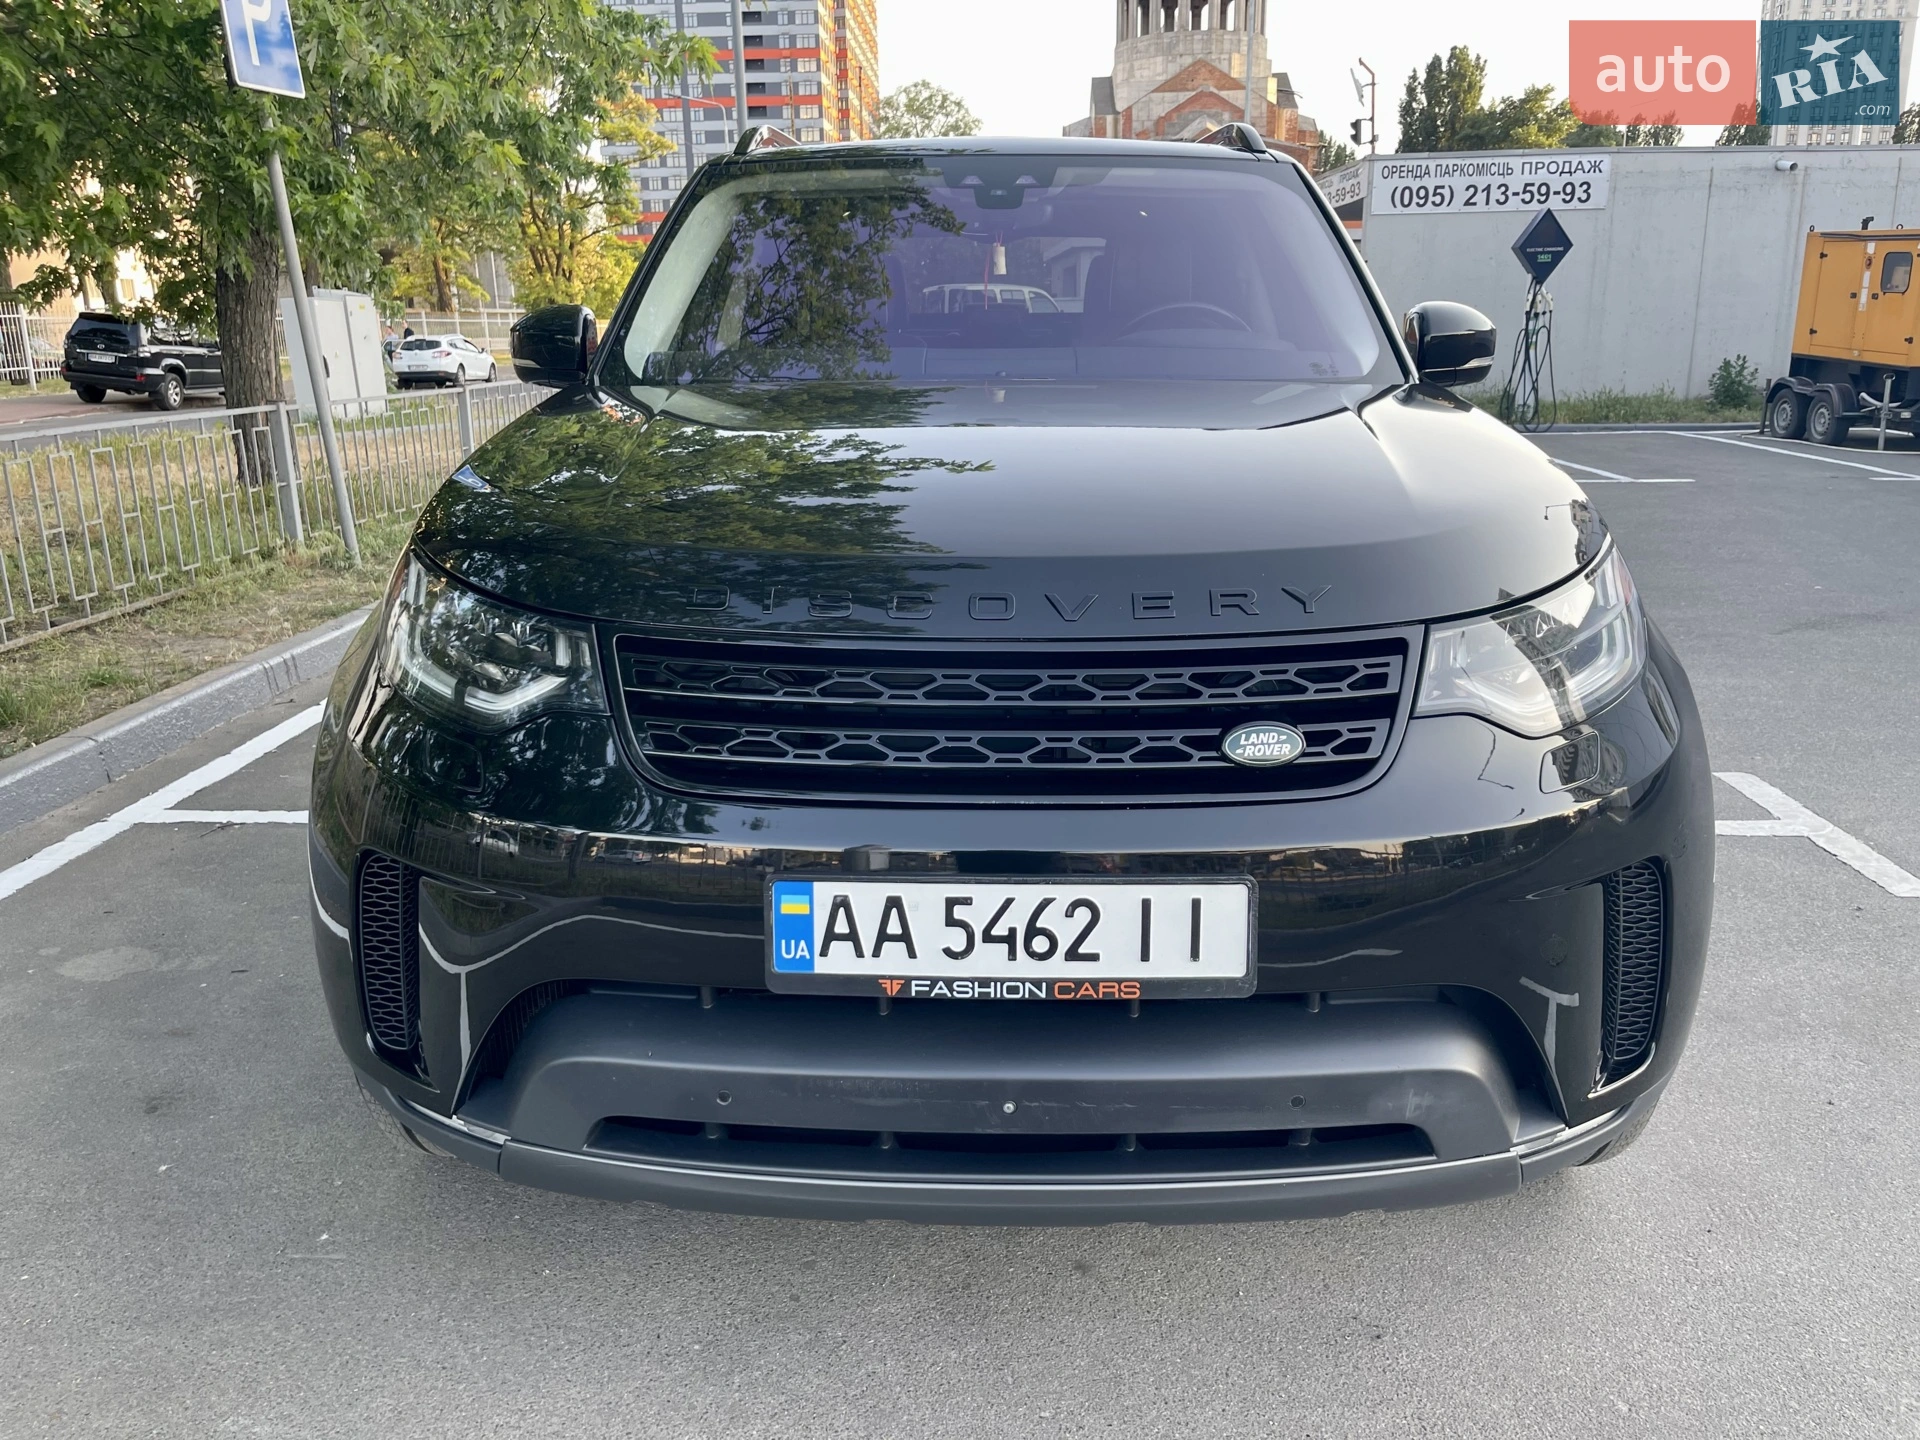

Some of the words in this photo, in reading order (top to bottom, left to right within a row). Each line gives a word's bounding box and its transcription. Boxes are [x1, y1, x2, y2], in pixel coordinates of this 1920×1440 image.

[1381, 164, 1432, 181] ОРЕНДА
[1434, 162, 1514, 179] ПАРКОМІСЦЬ
[1520, 159, 1604, 177] ПРОДАЖ
[1390, 185, 1455, 208] (095)
[1463, 181, 1592, 207] 213-59-93
[686, 585, 1332, 622] DISCOVERY
[1240, 732, 1278, 745] LAND
[1244, 743, 1291, 757] ROVER
[819, 895, 918, 959] AA
[941, 896, 1101, 962] 5462
[781, 939, 810, 959] UA
[911, 980, 1047, 998] FASHION
[1054, 981, 1141, 998] CARS
